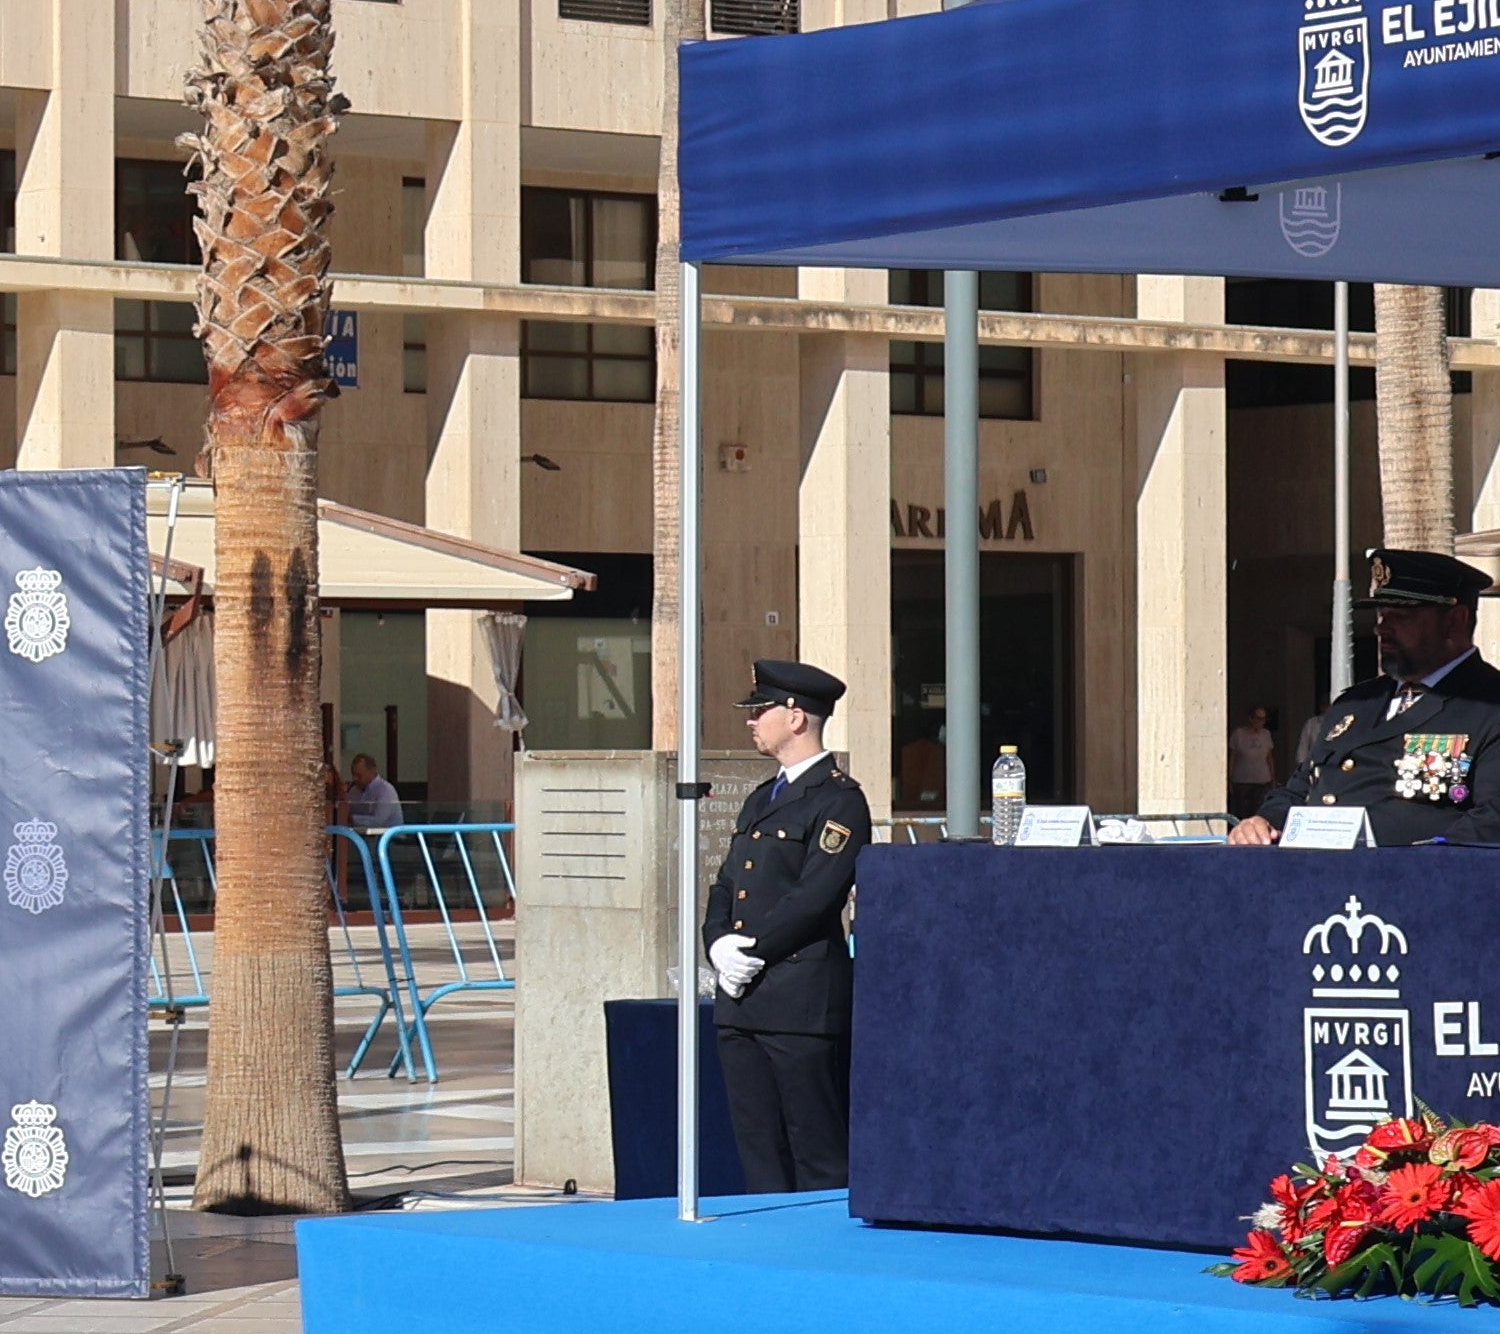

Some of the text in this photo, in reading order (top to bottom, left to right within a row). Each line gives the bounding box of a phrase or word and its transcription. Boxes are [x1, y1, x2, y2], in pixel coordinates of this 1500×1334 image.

[1305, 29, 1363, 52] MVRGI
[1382, 4, 1425, 44] EL
[1313, 1021, 1401, 1047] MVRGI
[1433, 1000, 1499, 1056] EL
